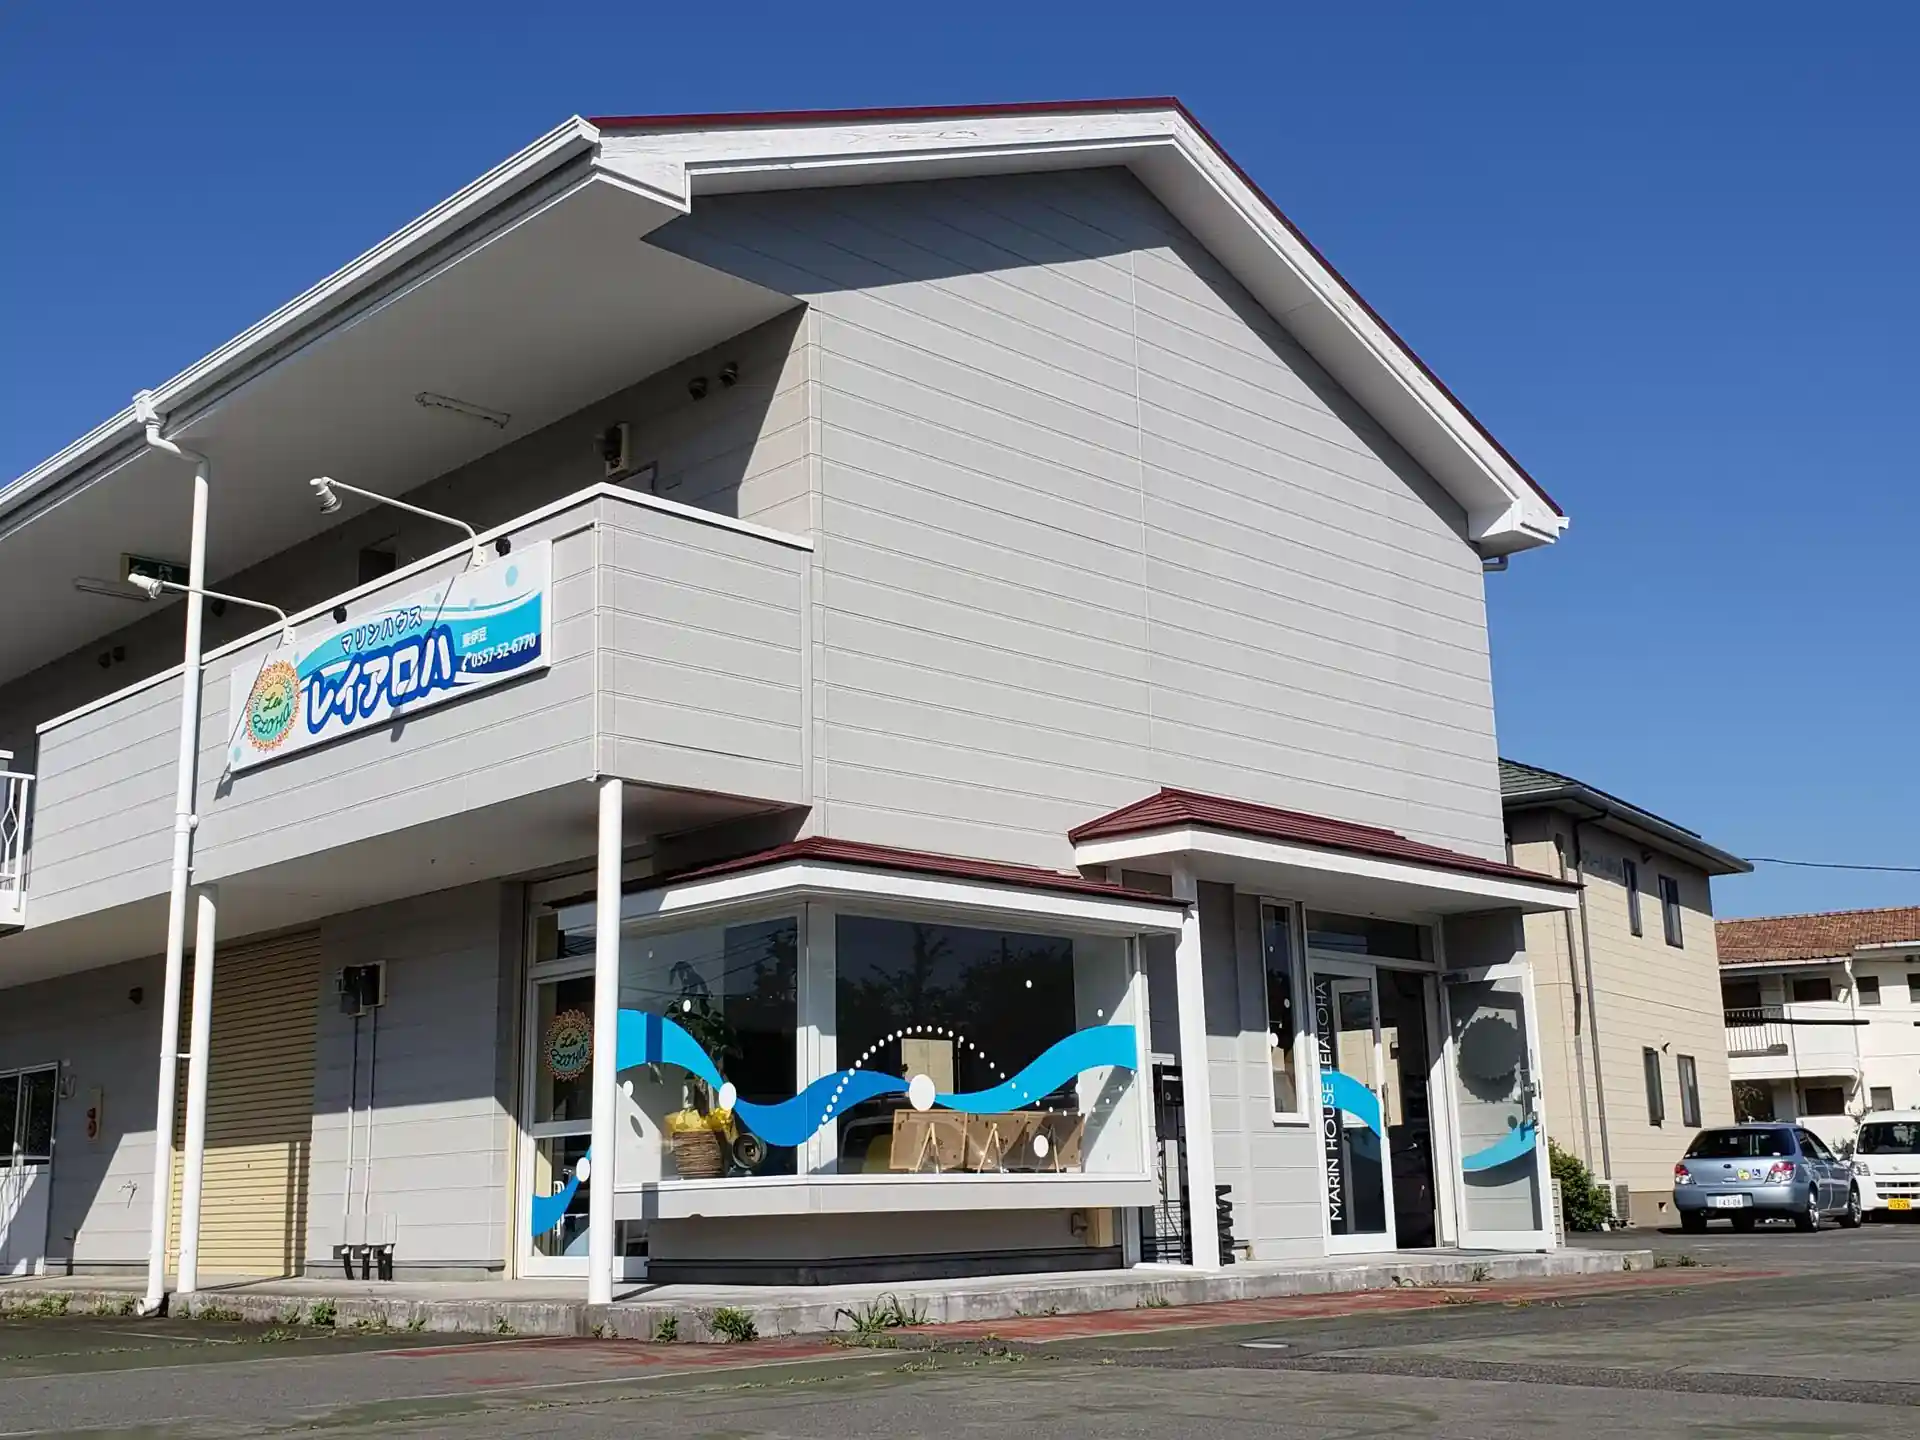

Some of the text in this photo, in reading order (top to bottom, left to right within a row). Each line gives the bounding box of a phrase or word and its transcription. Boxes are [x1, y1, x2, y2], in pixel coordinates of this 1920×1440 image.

[341, 605, 422, 655] マリンハウス
[471, 632, 536, 668] 0557-52-6770
[309, 629, 453, 731] レイアロハ
[1316, 981, 1342, 1221] MARIN HOUSE LEIALOHA
